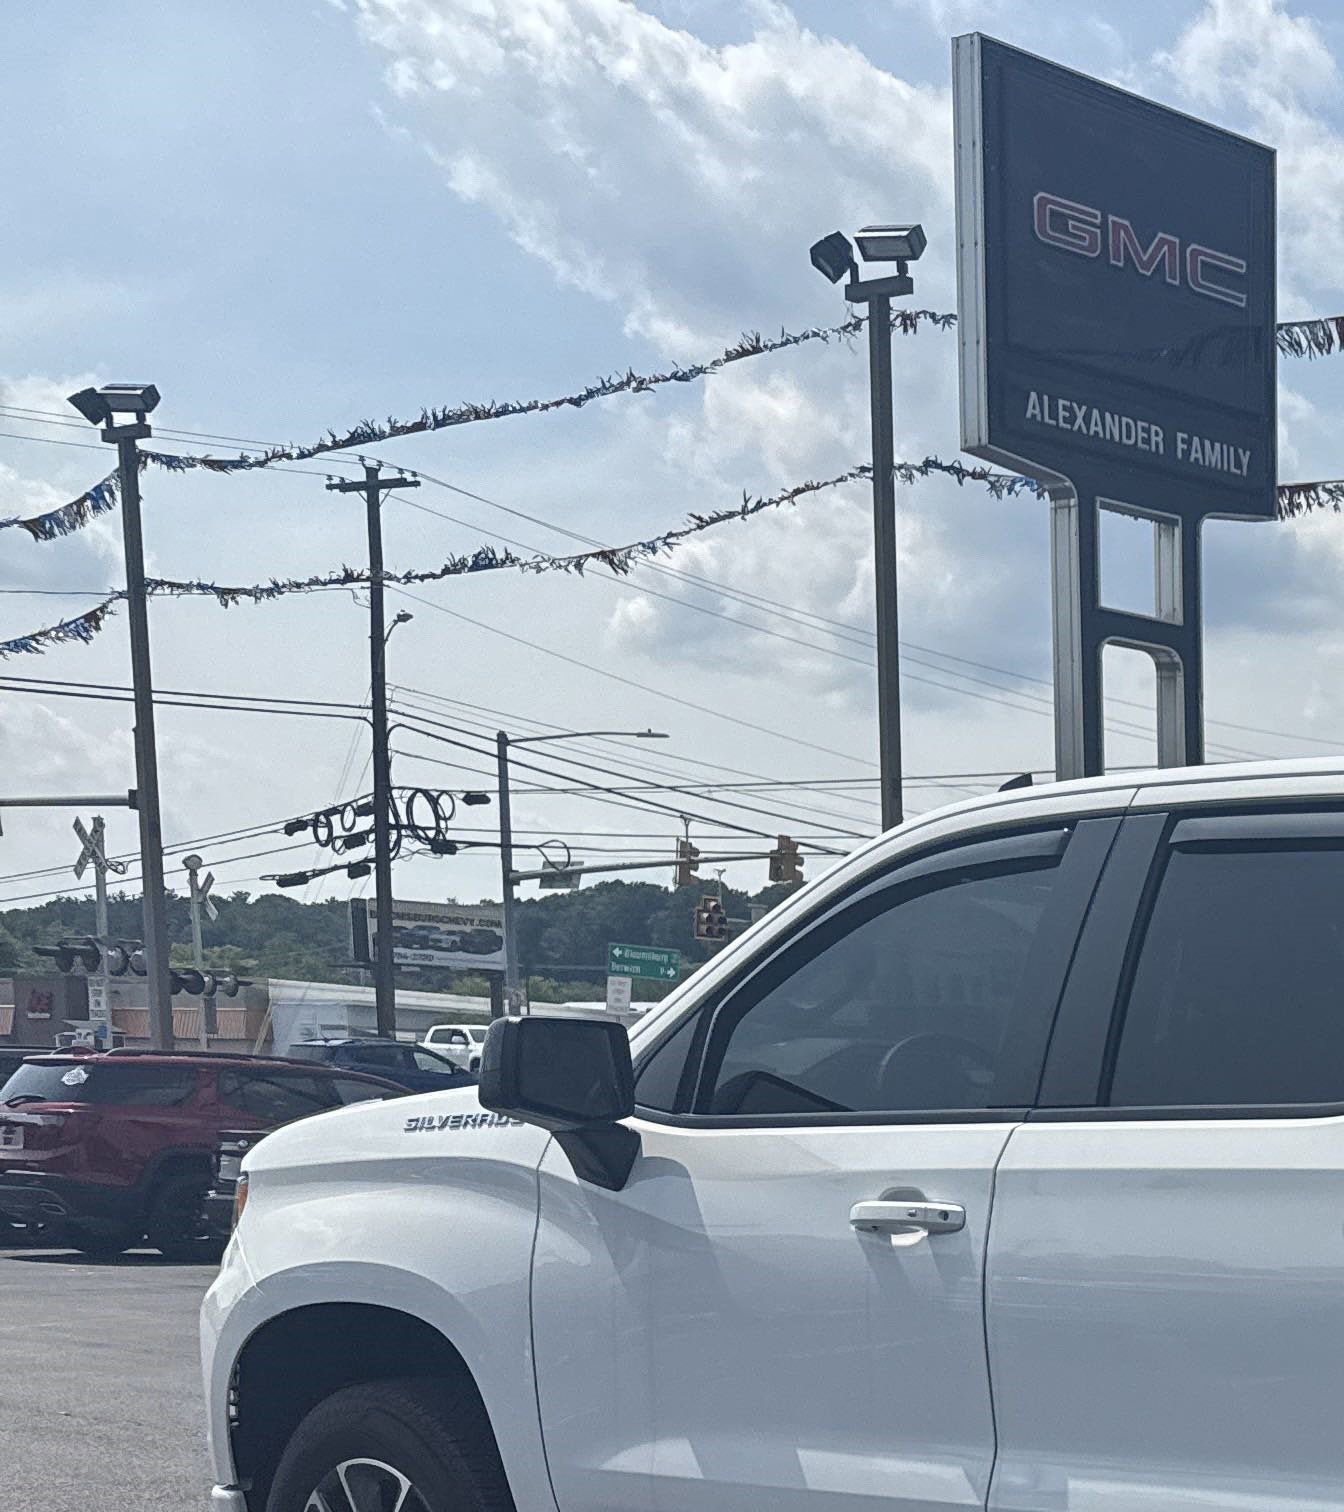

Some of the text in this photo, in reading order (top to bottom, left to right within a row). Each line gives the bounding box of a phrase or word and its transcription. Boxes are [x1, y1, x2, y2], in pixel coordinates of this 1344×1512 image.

[1033, 192, 1247, 307] GMC
[1026, 392, 1251, 477] ALEXANDER FAMILY
